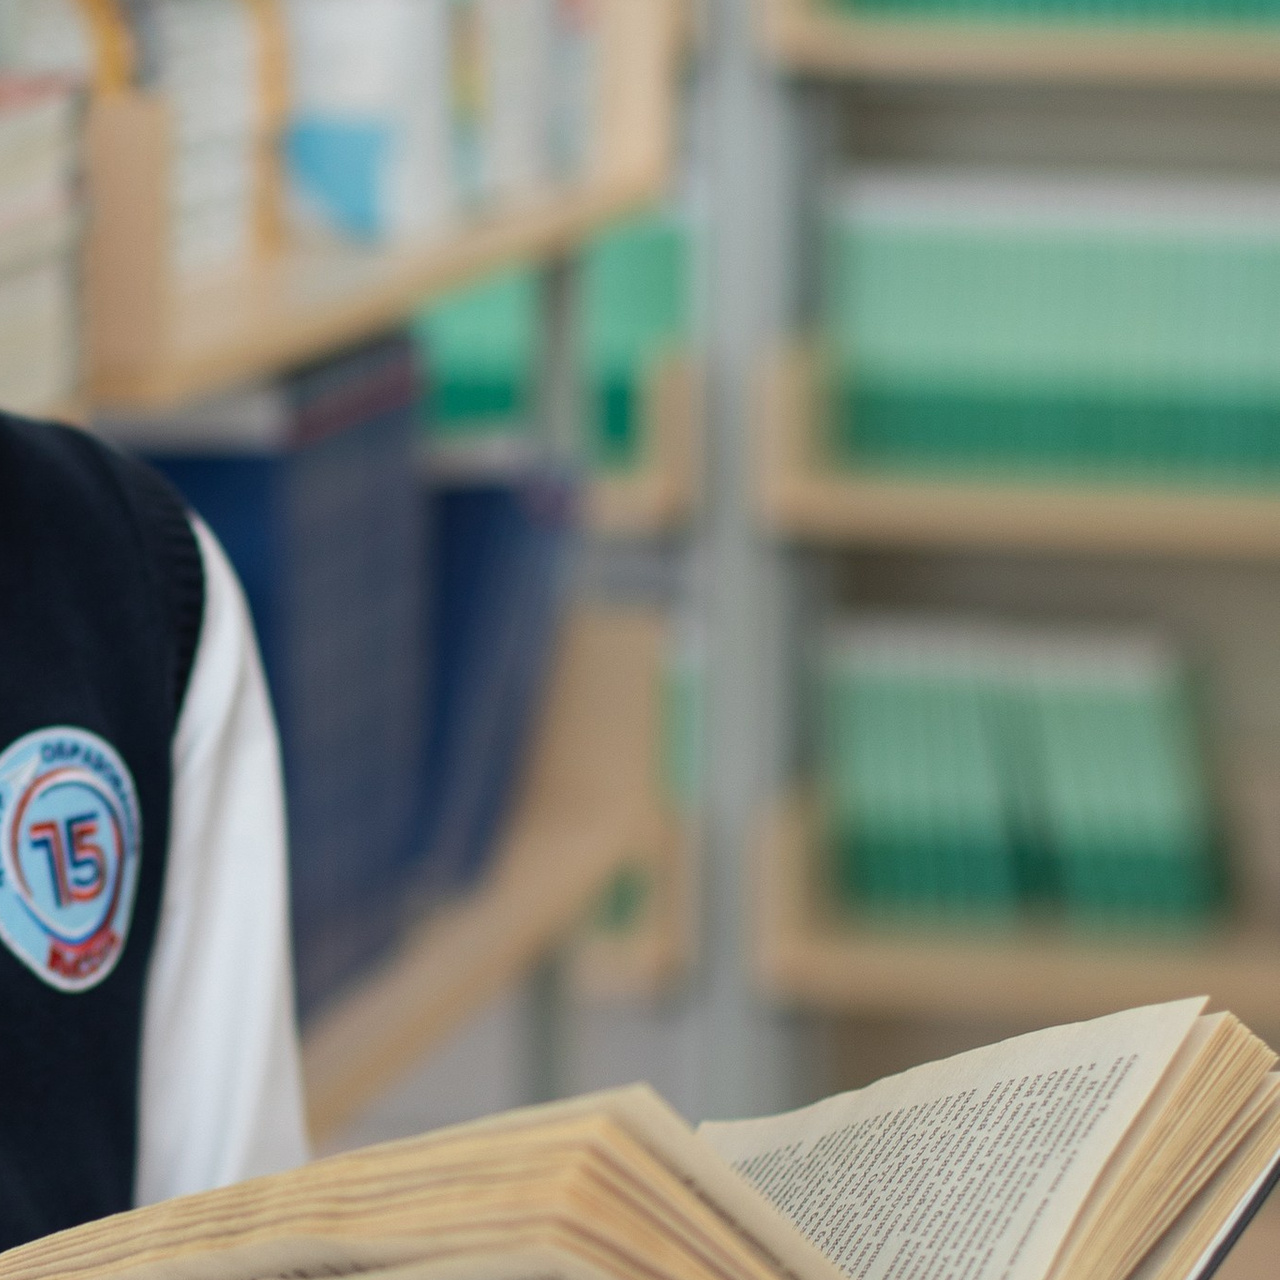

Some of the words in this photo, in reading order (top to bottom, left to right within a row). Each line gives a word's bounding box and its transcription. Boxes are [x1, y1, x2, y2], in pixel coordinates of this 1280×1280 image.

[29, 811, 108, 908] 15
[1022, 1073, 1044, 1099] кой
[1035, 1070, 1059, 1097] Она
[940, 1090, 967, 1124] было
[954, 1103, 979, 1131] Том
[976, 1078, 1016, 1132] каждый
[987, 1075, 1030, 1133] емкость,
[927, 1125, 942, 1141] во
[929, 1129, 951, 1154] Это
[983, 1101, 1025, 1158] овсянки
[893, 1132, 917, 1160] Она
[910, 1141, 931, 1165] что
[932, 1132, 956, 1163] стал
[953, 1135, 978, 1167] день
[956, 1135, 990, 1182] словно
[854, 1172, 879, 1200] Она
[941, 1169, 955, 1186] до
[860, 1195, 881, 1221] она
[884, 1186, 899, 1202] то
[940, 1184, 959, 1207] это
[896, 1181, 936, 1237] пойлом.
[919, 1209, 944, 1237] был
[844, 1223, 873, 1262] стало
